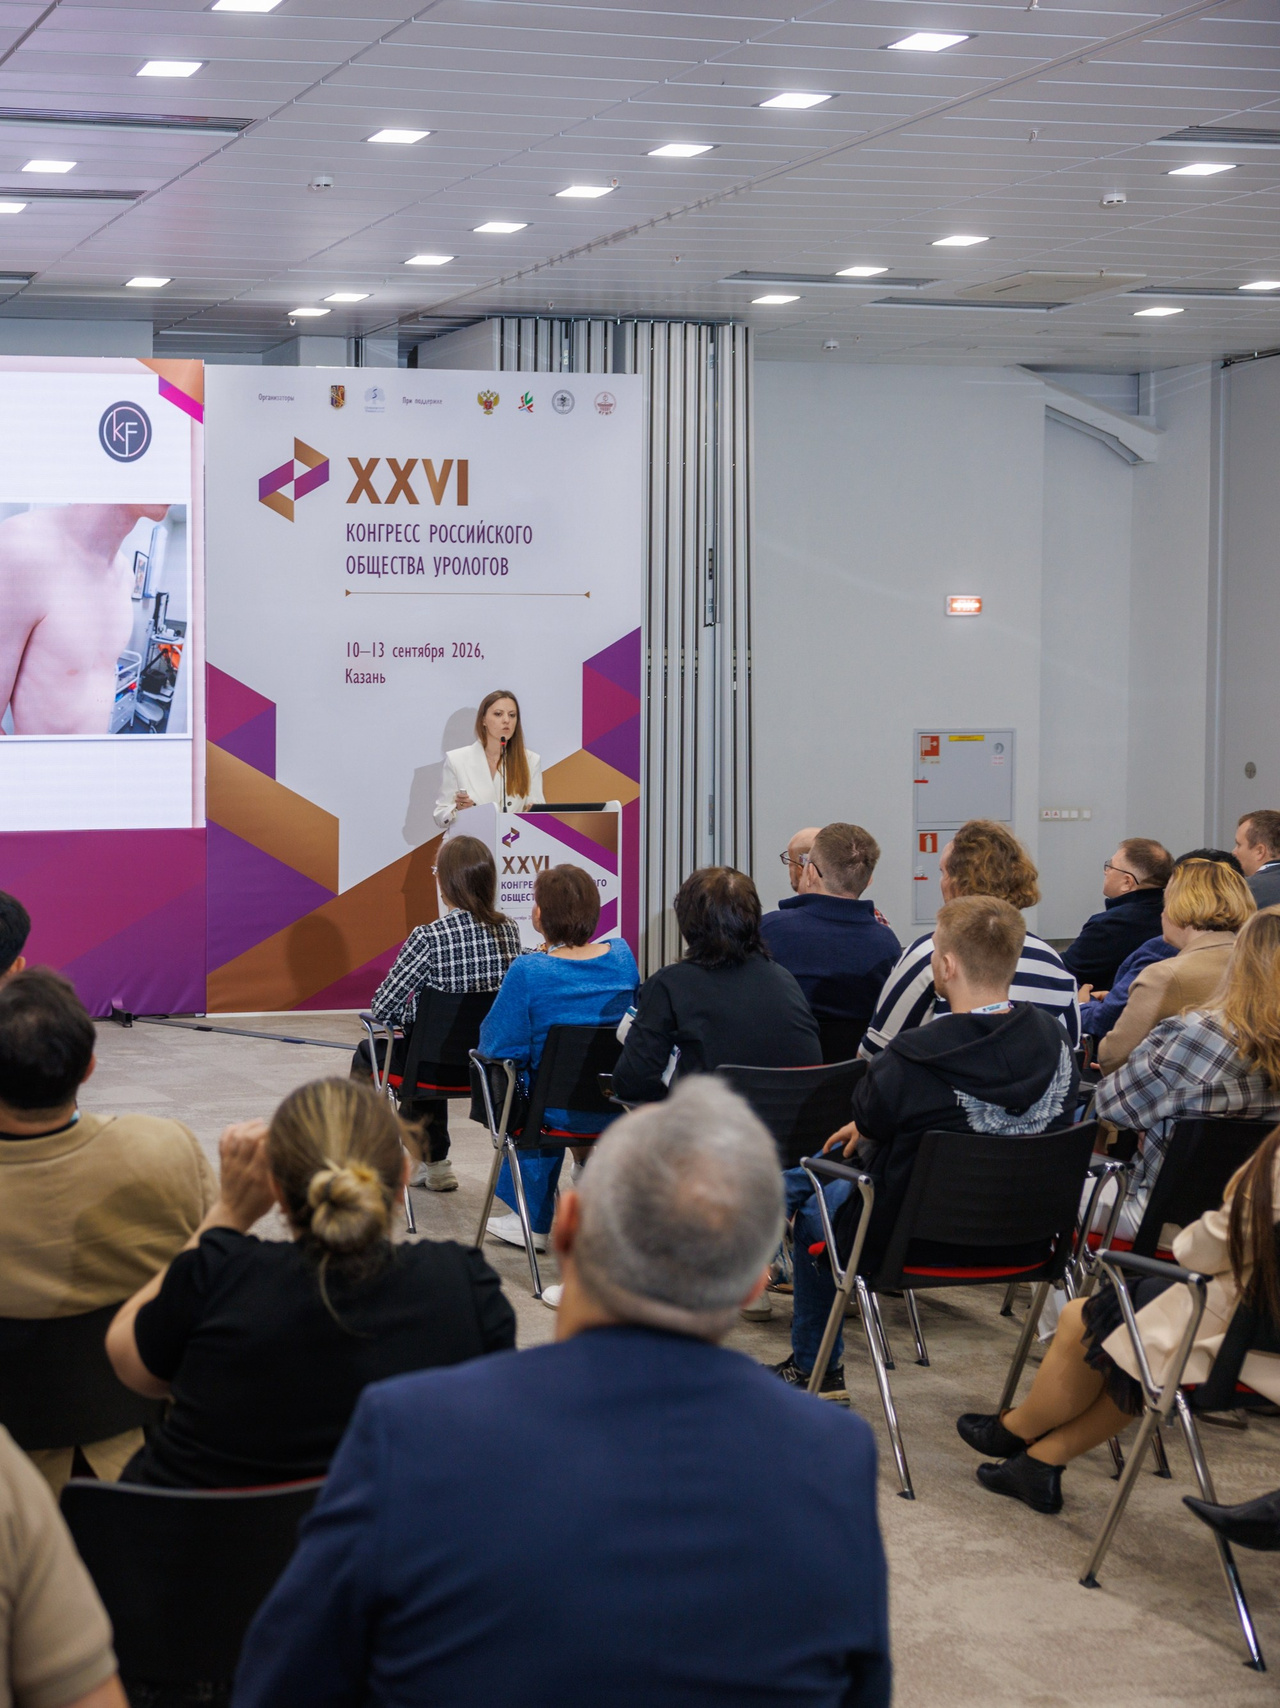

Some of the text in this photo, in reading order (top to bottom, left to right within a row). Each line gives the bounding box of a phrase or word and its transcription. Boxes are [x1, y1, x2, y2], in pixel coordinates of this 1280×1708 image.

[346, 457, 469, 506] XXVI
[346, 520, 533, 545] КОНГРЕСС РОССИЙСКОГО
[346, 555, 509, 578] ОБЩЕСТВА УРОЛОГОВ
[392, 643, 445, 663] сентября
[451, 642, 485, 660] 2026,
[345, 668, 386, 684] Казань
[502, 855, 550, 875] XXVI
[500, 880, 534, 889] КОНГРЕ
[500, 893, 535, 903] ОБЩЕСТ
